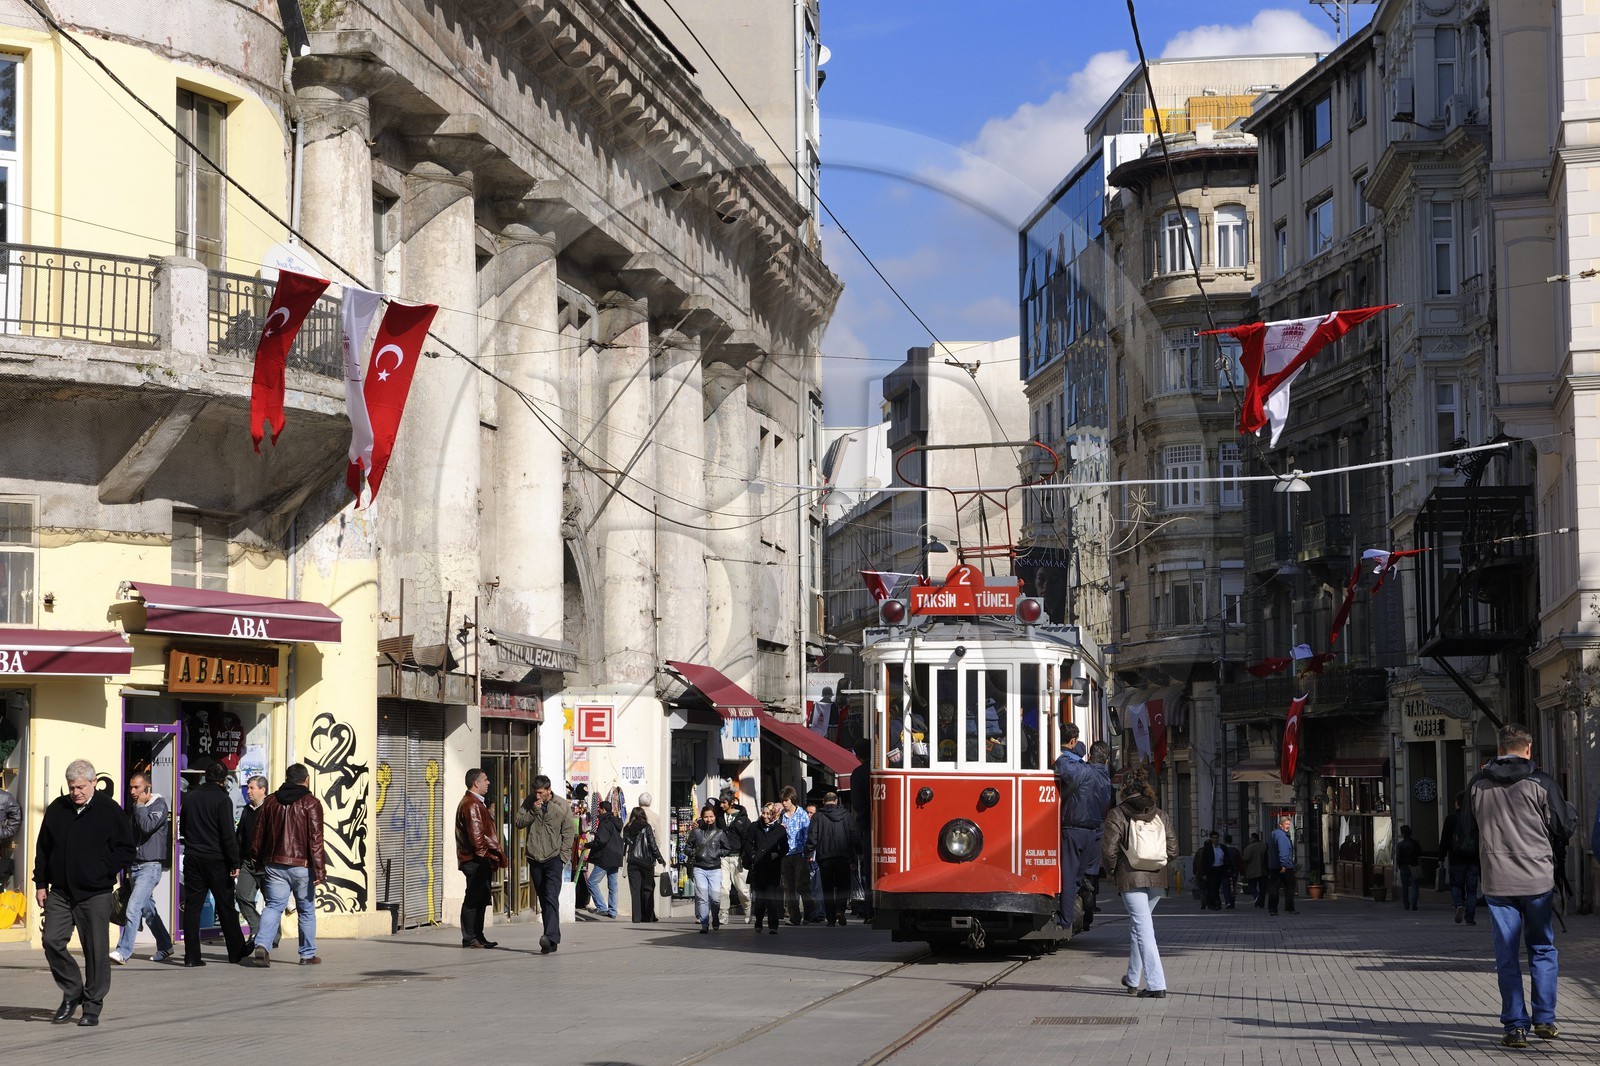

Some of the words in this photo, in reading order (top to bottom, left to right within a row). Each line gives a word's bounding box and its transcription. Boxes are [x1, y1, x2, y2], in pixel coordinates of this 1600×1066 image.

[959, 567, 971, 586] 2
[916, 591, 957, 608] TAKSİM
[975, 591, 1014, 608] TÜNEL
[585, 712, 606, 738] E
[1413, 718, 1446, 737] COFFEE
[1038, 785, 1056, 803] 223
